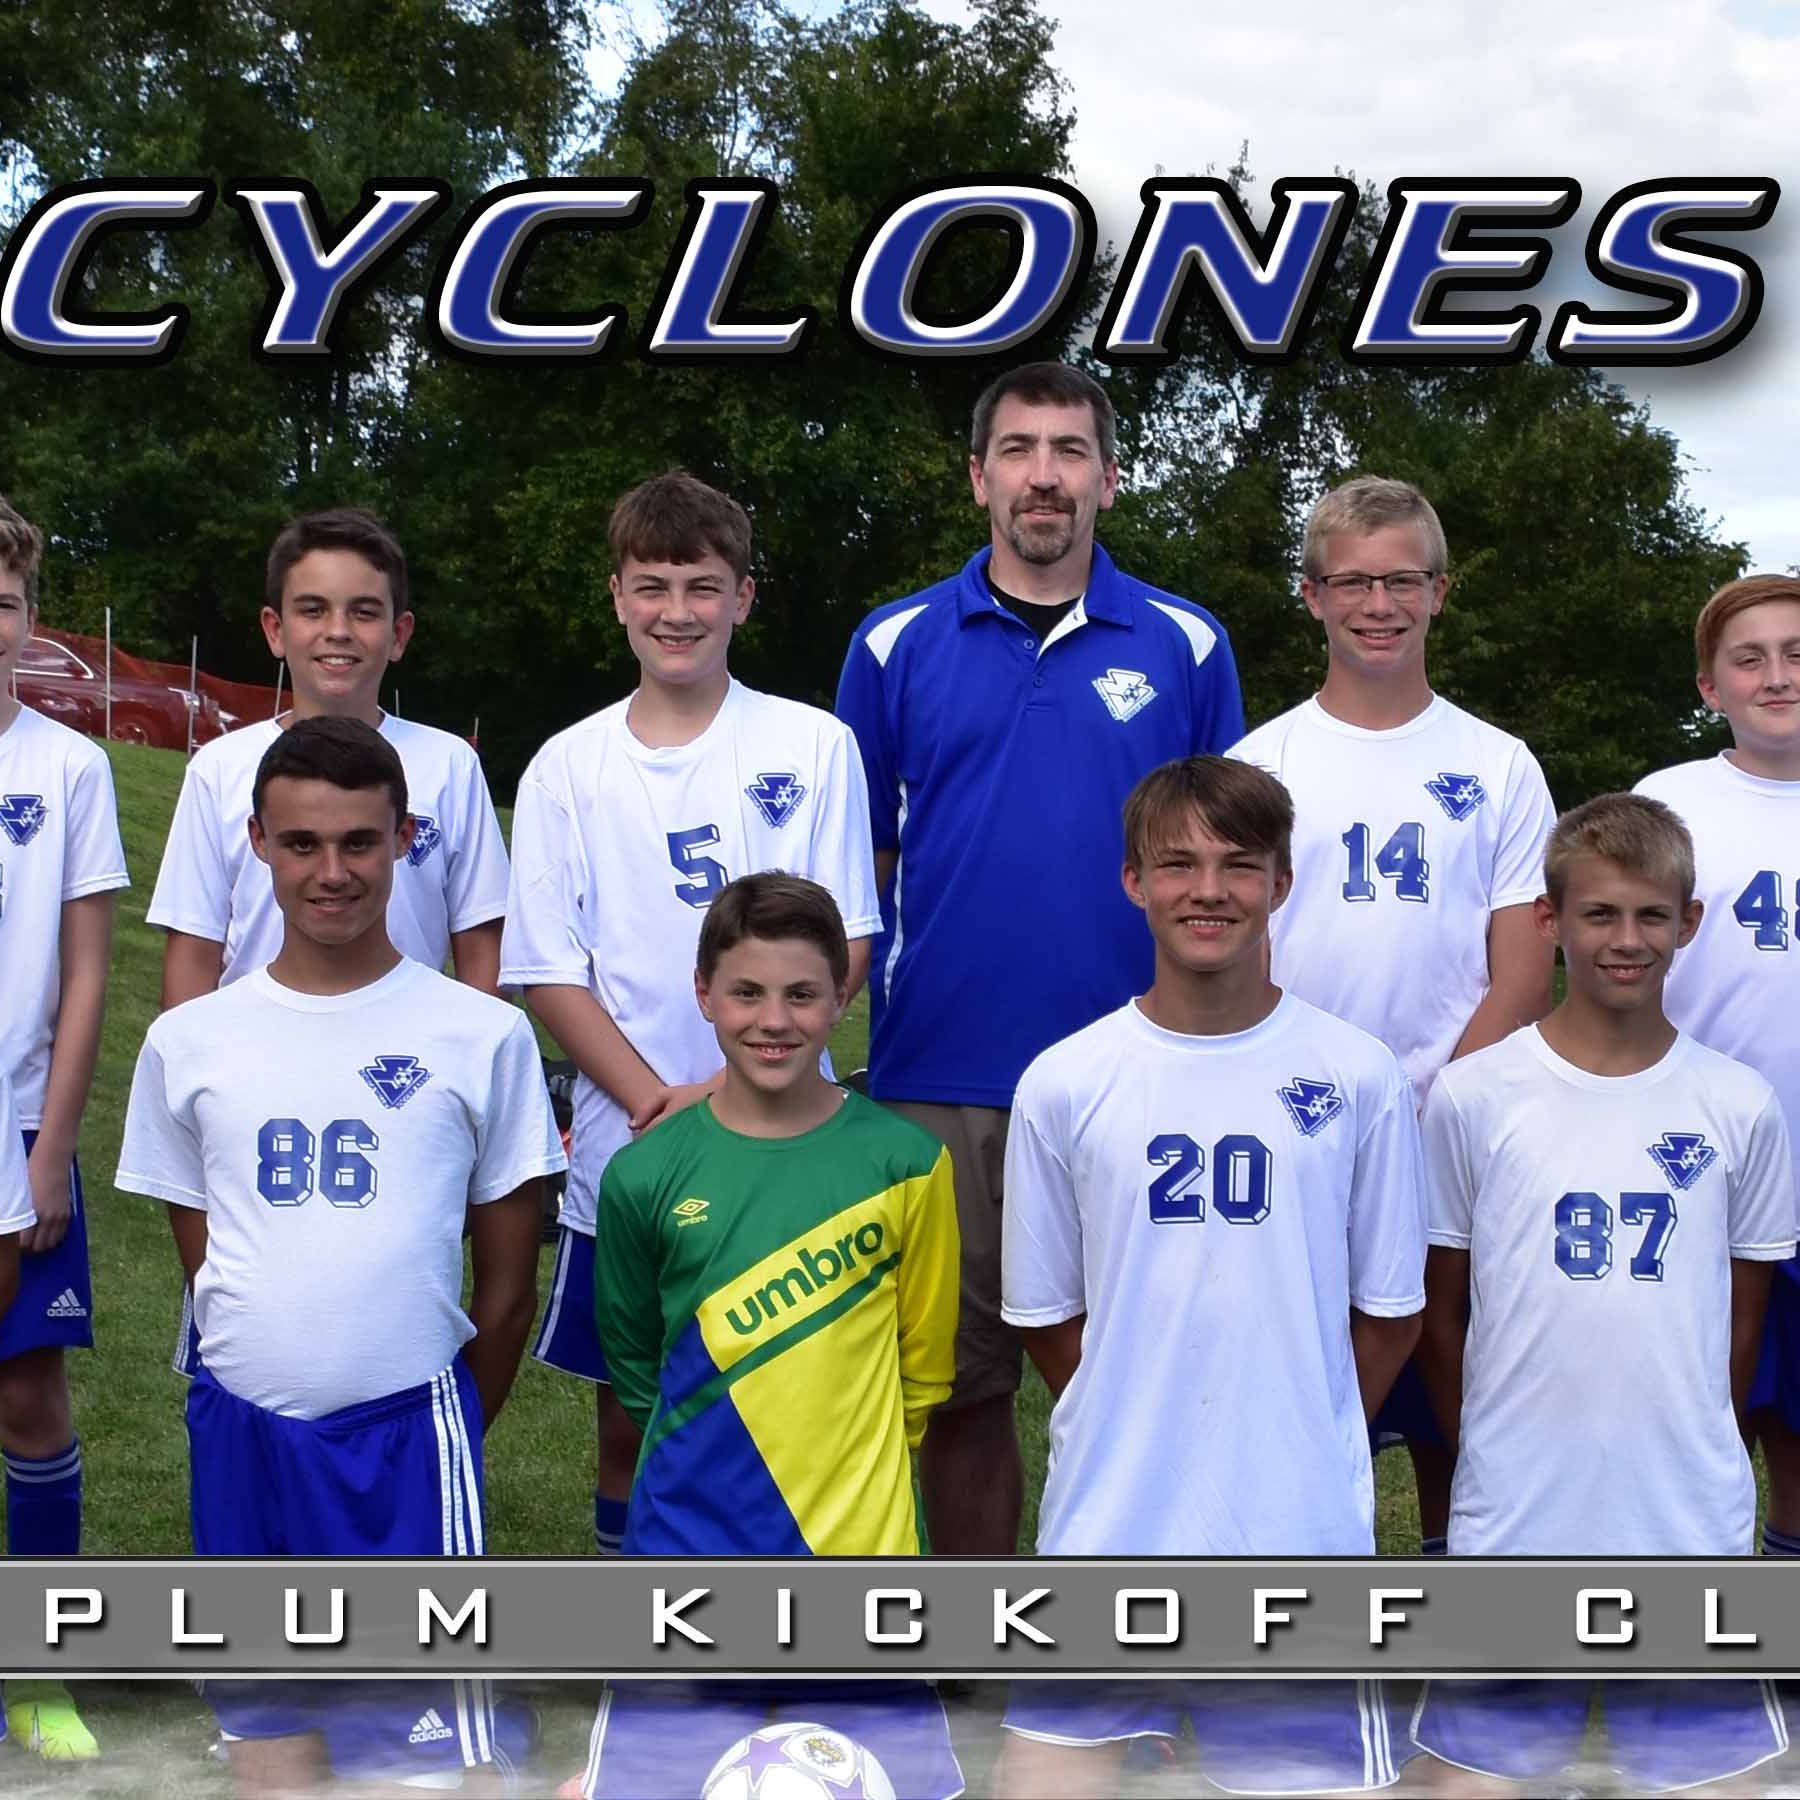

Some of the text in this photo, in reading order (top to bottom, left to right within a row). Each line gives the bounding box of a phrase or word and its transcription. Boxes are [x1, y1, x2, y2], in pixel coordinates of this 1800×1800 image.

[667, 824, 729, 910] 5
[1343, 823, 1430, 904] 14
[256, 1118, 381, 1209] 86
[1147, 1134, 1274, 1226] 20
[725, 1222, 884, 1336] umbro
[1554, 1192, 1679, 1283] 87
[46, 1305, 88, 1317] adidas
[409, 1727, 453, 1743] adidas
